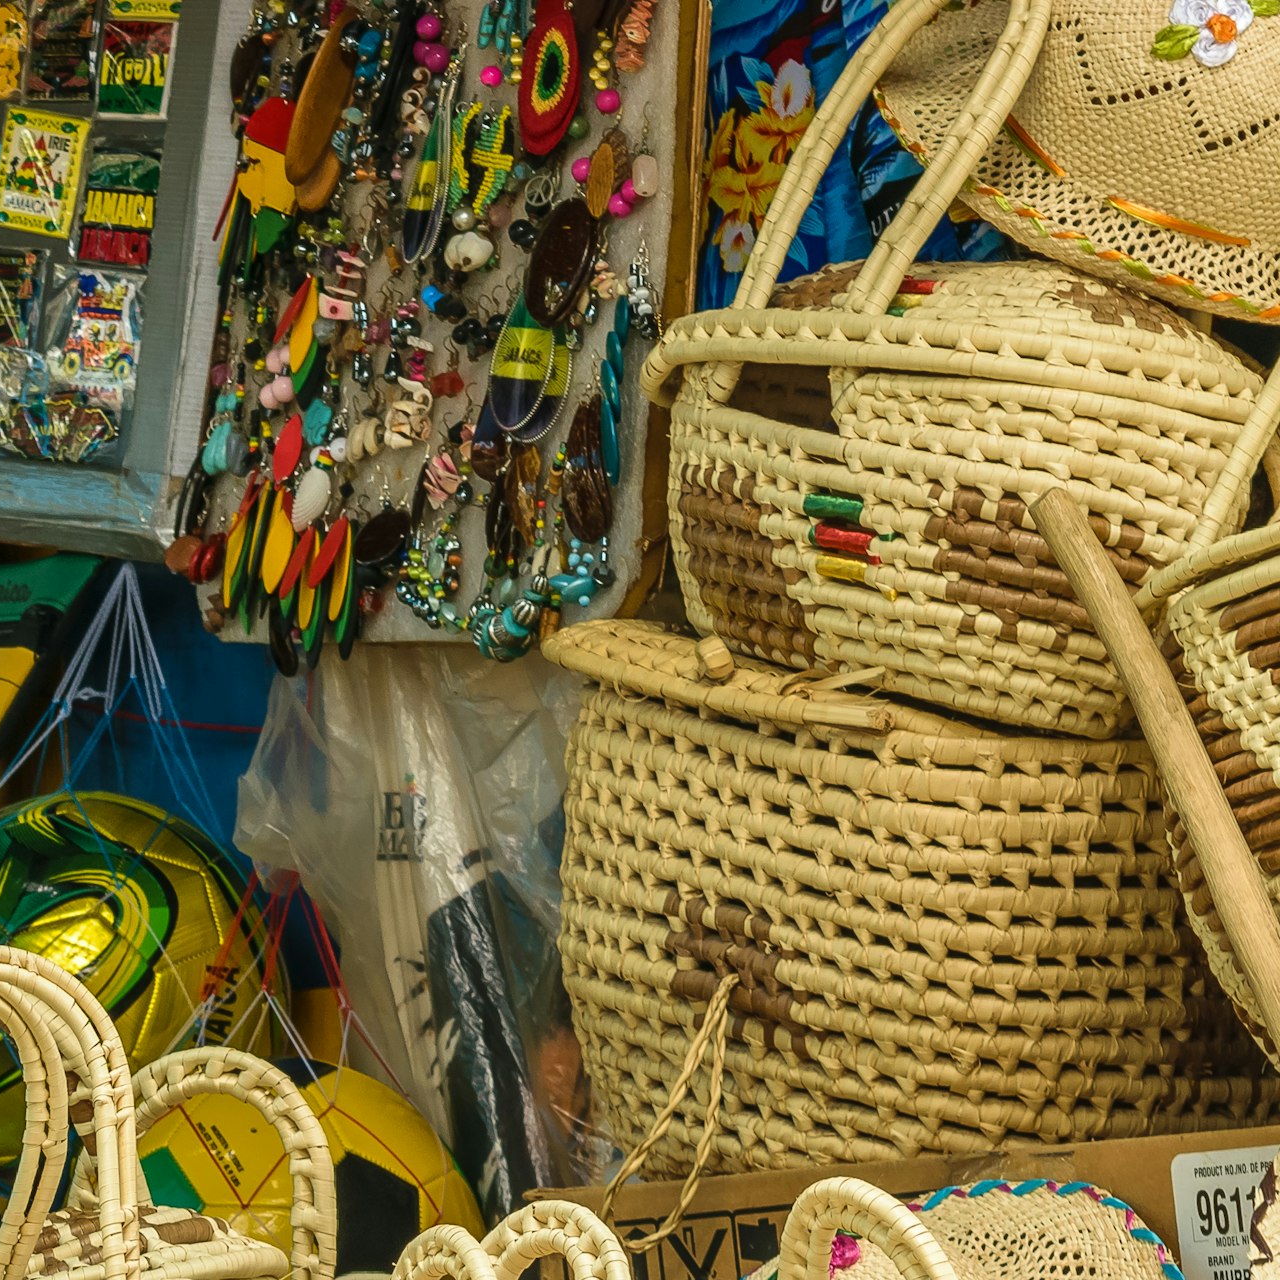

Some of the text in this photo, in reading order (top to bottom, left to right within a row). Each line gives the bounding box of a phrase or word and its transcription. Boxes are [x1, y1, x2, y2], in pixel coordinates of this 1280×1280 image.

[48, 135, 72, 153] IRIE
[4, 195, 47, 214] JAMAICA
[83, 190, 154, 229] JAMAICA
[1193, 1165, 1223, 1179] PRODUCT
[1250, 1162, 1259, 1173] DE
[1215, 1235, 1240, 1248] MODEL
[1208, 1254, 1235, 1267] BRAND
